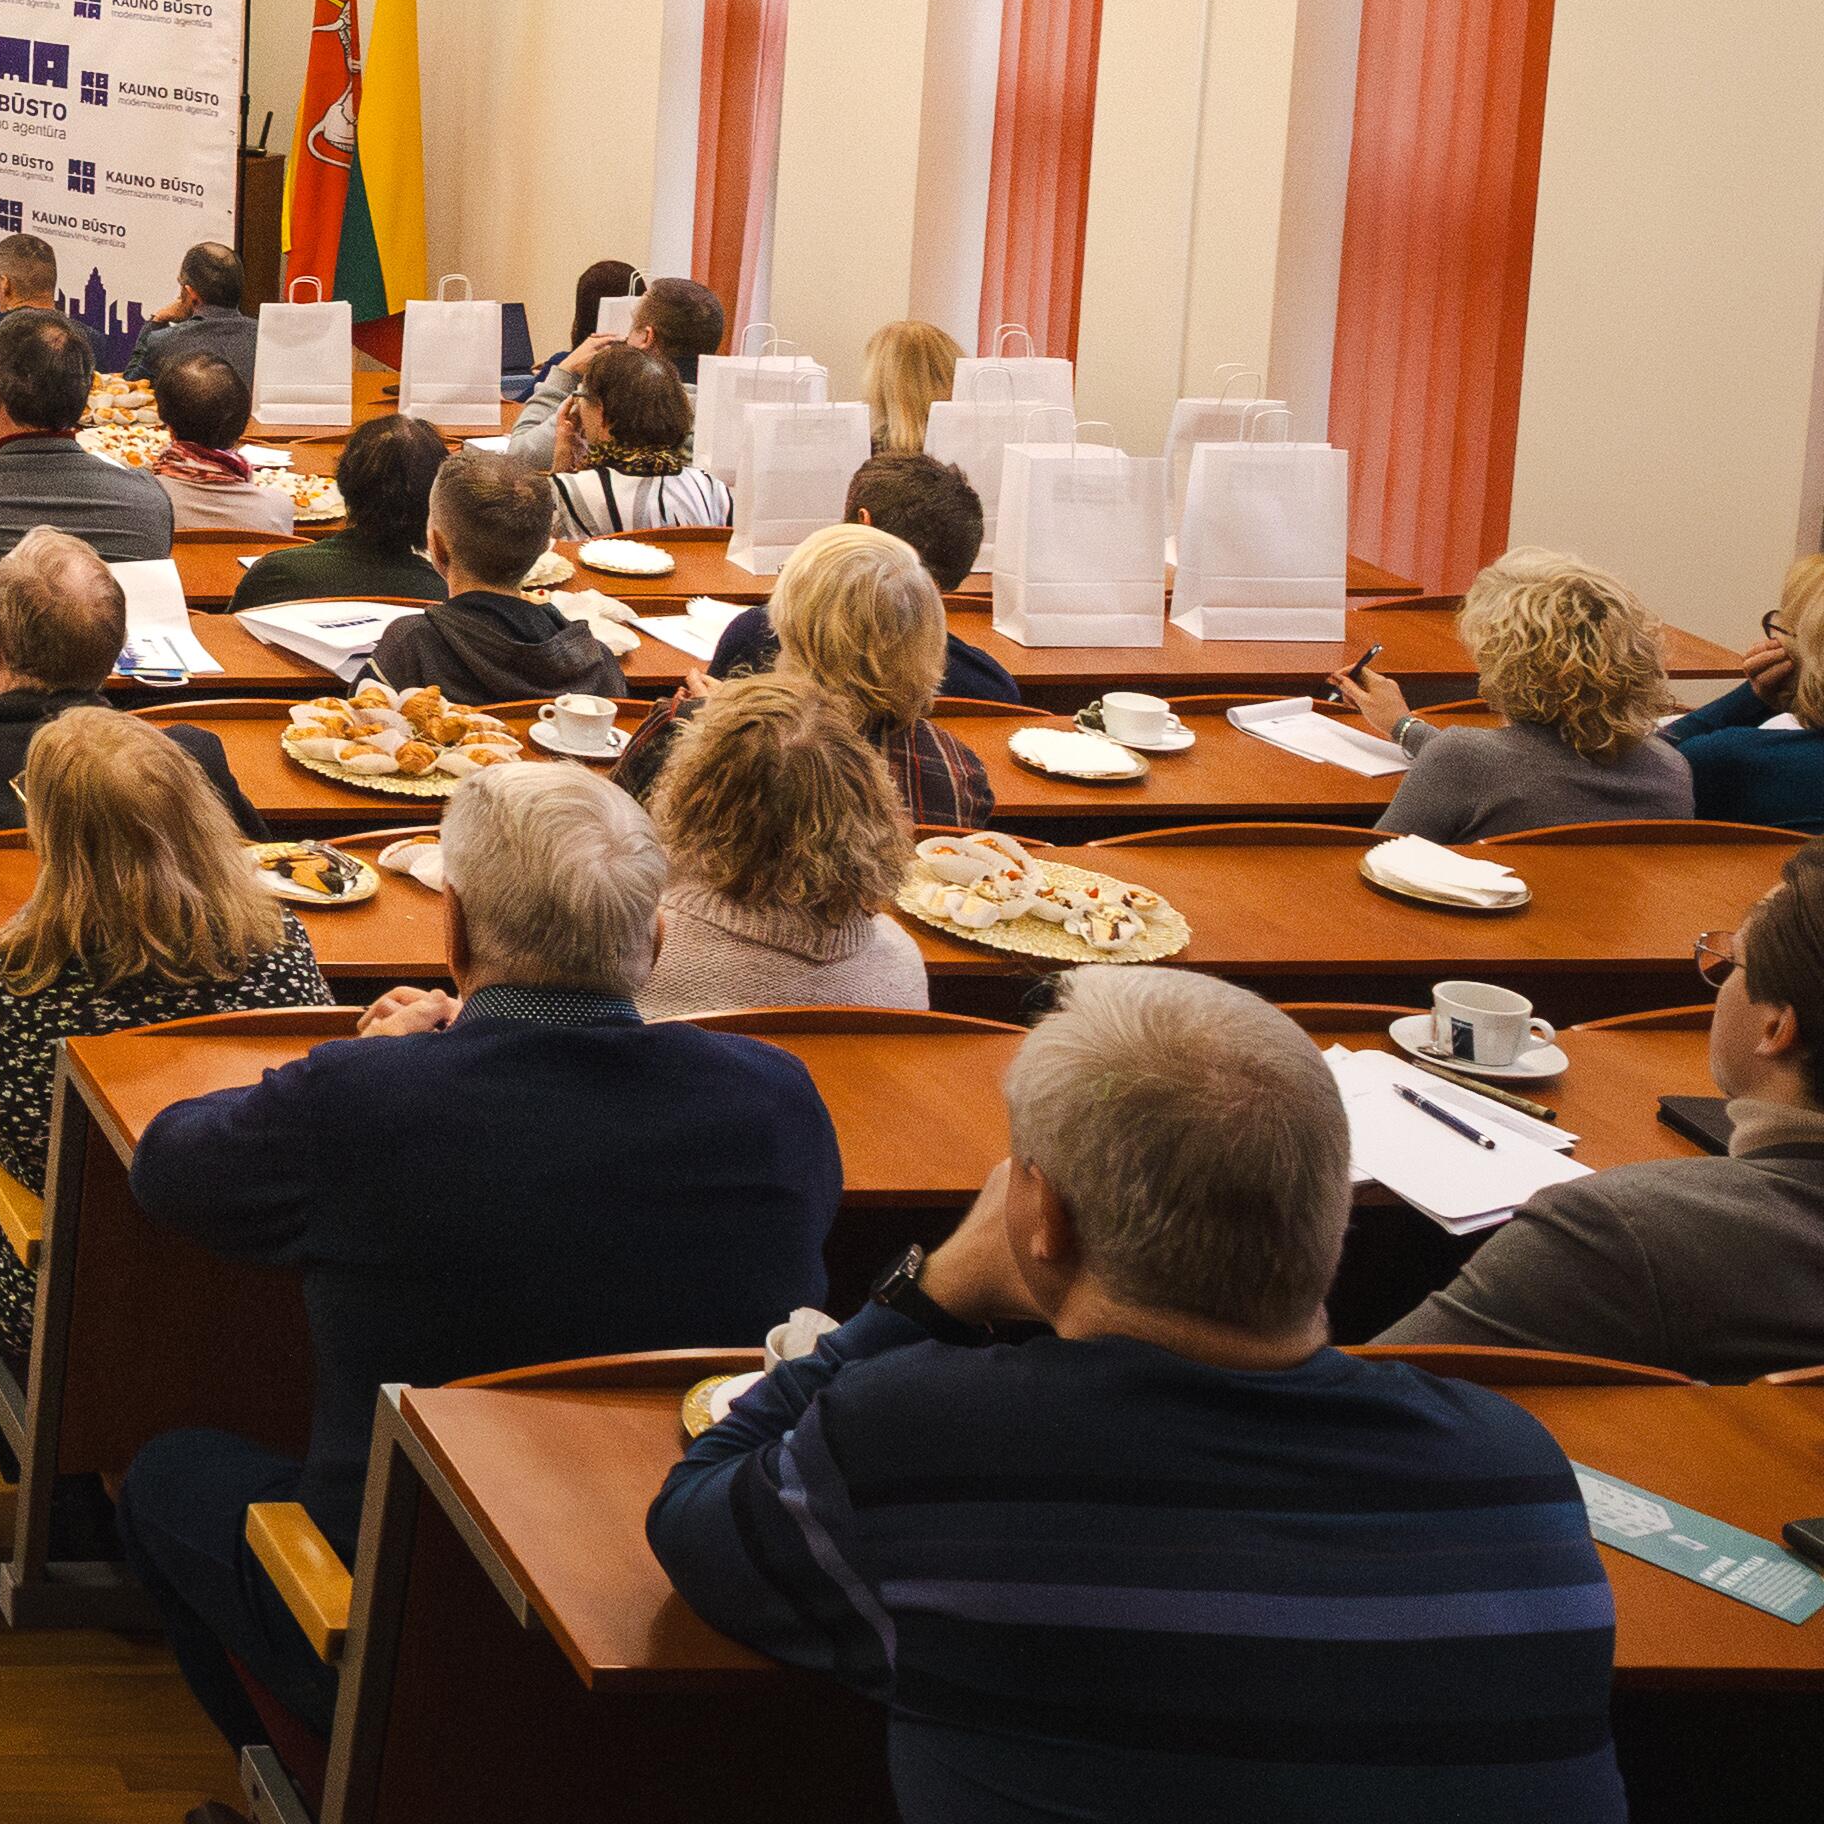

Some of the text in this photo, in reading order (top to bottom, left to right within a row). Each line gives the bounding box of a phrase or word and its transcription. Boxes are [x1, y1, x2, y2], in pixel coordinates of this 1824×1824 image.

[164, 0, 212, 16] BŪSTO
[119, 82, 219, 106] KAUNO BŪSTO
[13, 122, 66, 140] agentūra
[12, 153, 53, 172] BŪSTO
[106, 171, 204, 196] KAUNO BŪSTO
[32, 210, 126, 238] KAUNO BŪSTO
